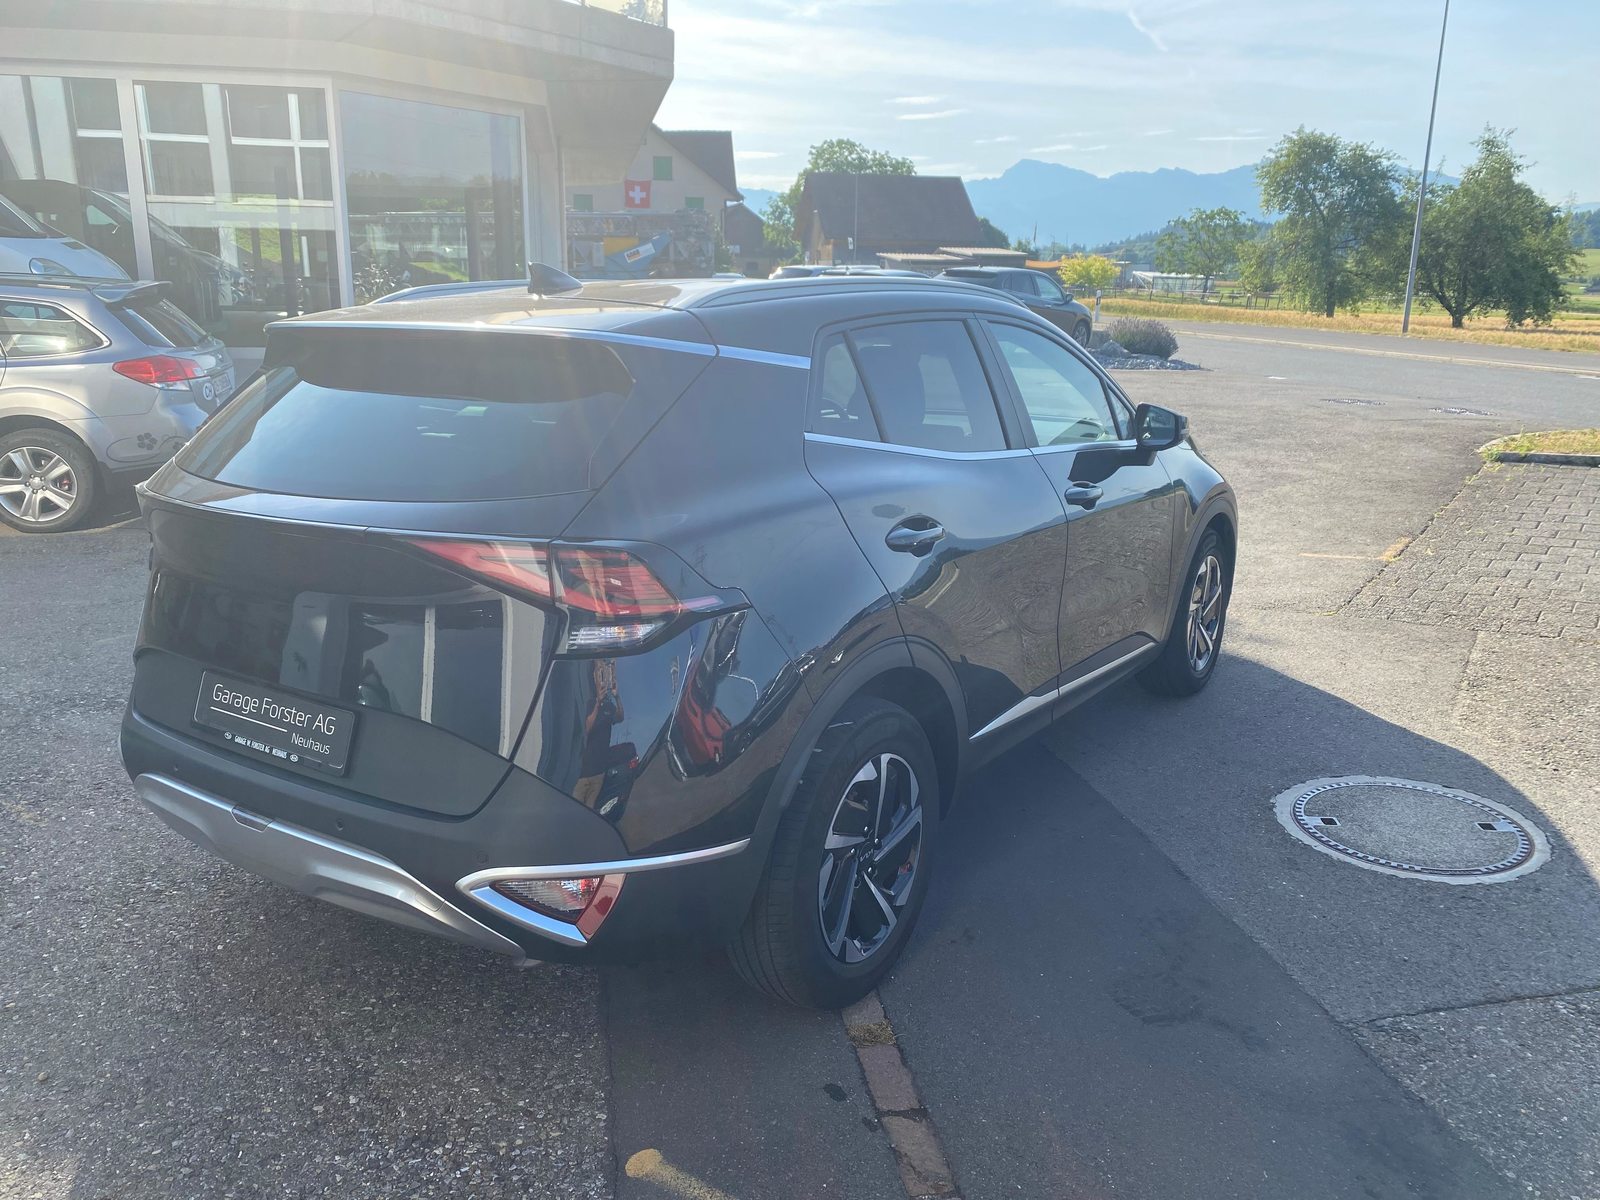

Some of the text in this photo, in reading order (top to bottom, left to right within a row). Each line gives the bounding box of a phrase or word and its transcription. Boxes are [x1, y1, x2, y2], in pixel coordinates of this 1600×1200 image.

[213, 684, 336, 736] Garage Forster AG
[234, 736, 246, 746] GARAGE
[251, 741, 264, 751] FORSTER
[264, 745, 270, 754] AG
[272, 748, 288, 758] NEUHAUS
[291, 732, 330, 755] Neuhaus
